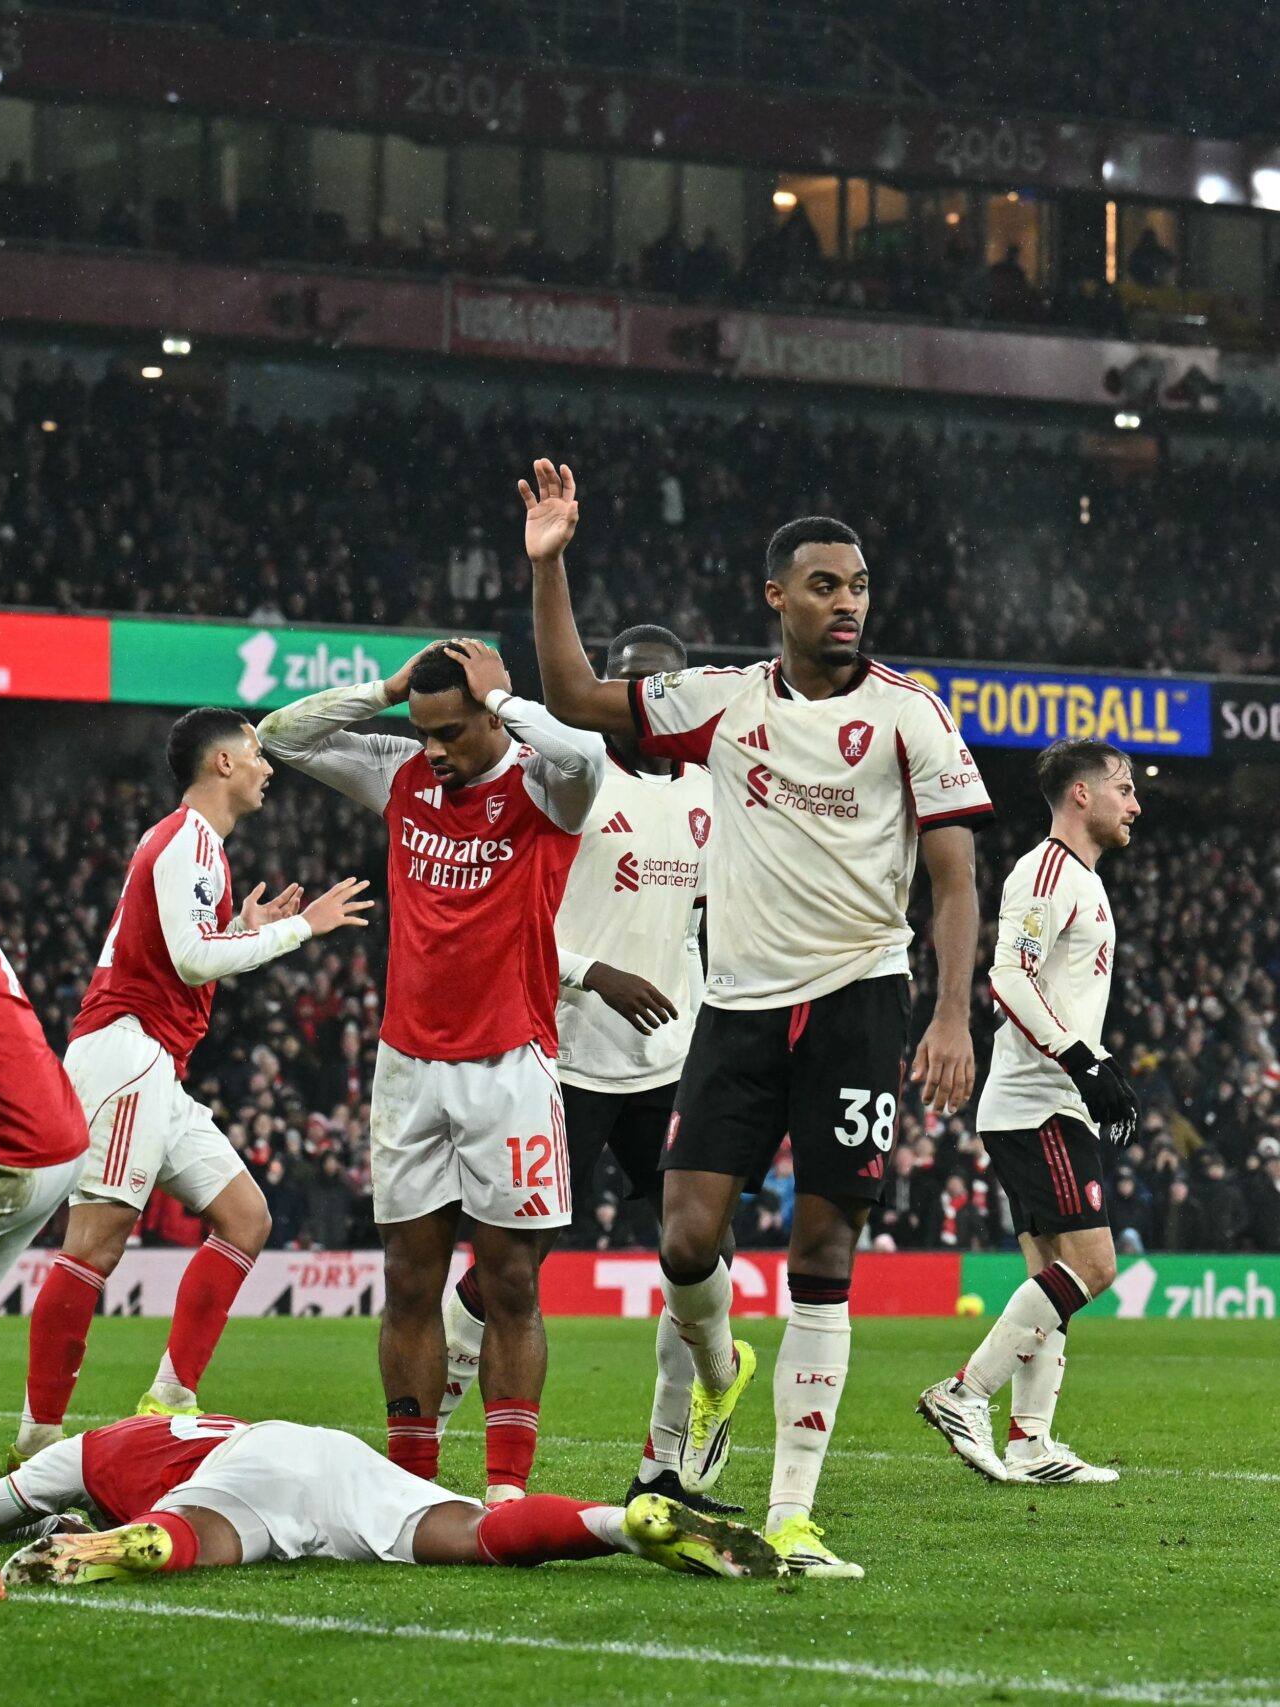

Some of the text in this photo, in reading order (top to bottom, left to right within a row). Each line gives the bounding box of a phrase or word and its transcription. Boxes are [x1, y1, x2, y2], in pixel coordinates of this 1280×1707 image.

[778, 778, 855, 802] standard
[774, 792, 859, 818] chartered
[401, 816, 514, 864] Emirates
[430, 861, 492, 890] BETTER
[643, 858, 699, 874] standard
[834, 1088, 896, 1152] 38
[506, 1135, 553, 1188] 12
[795, 1373, 838, 1386] LFC
